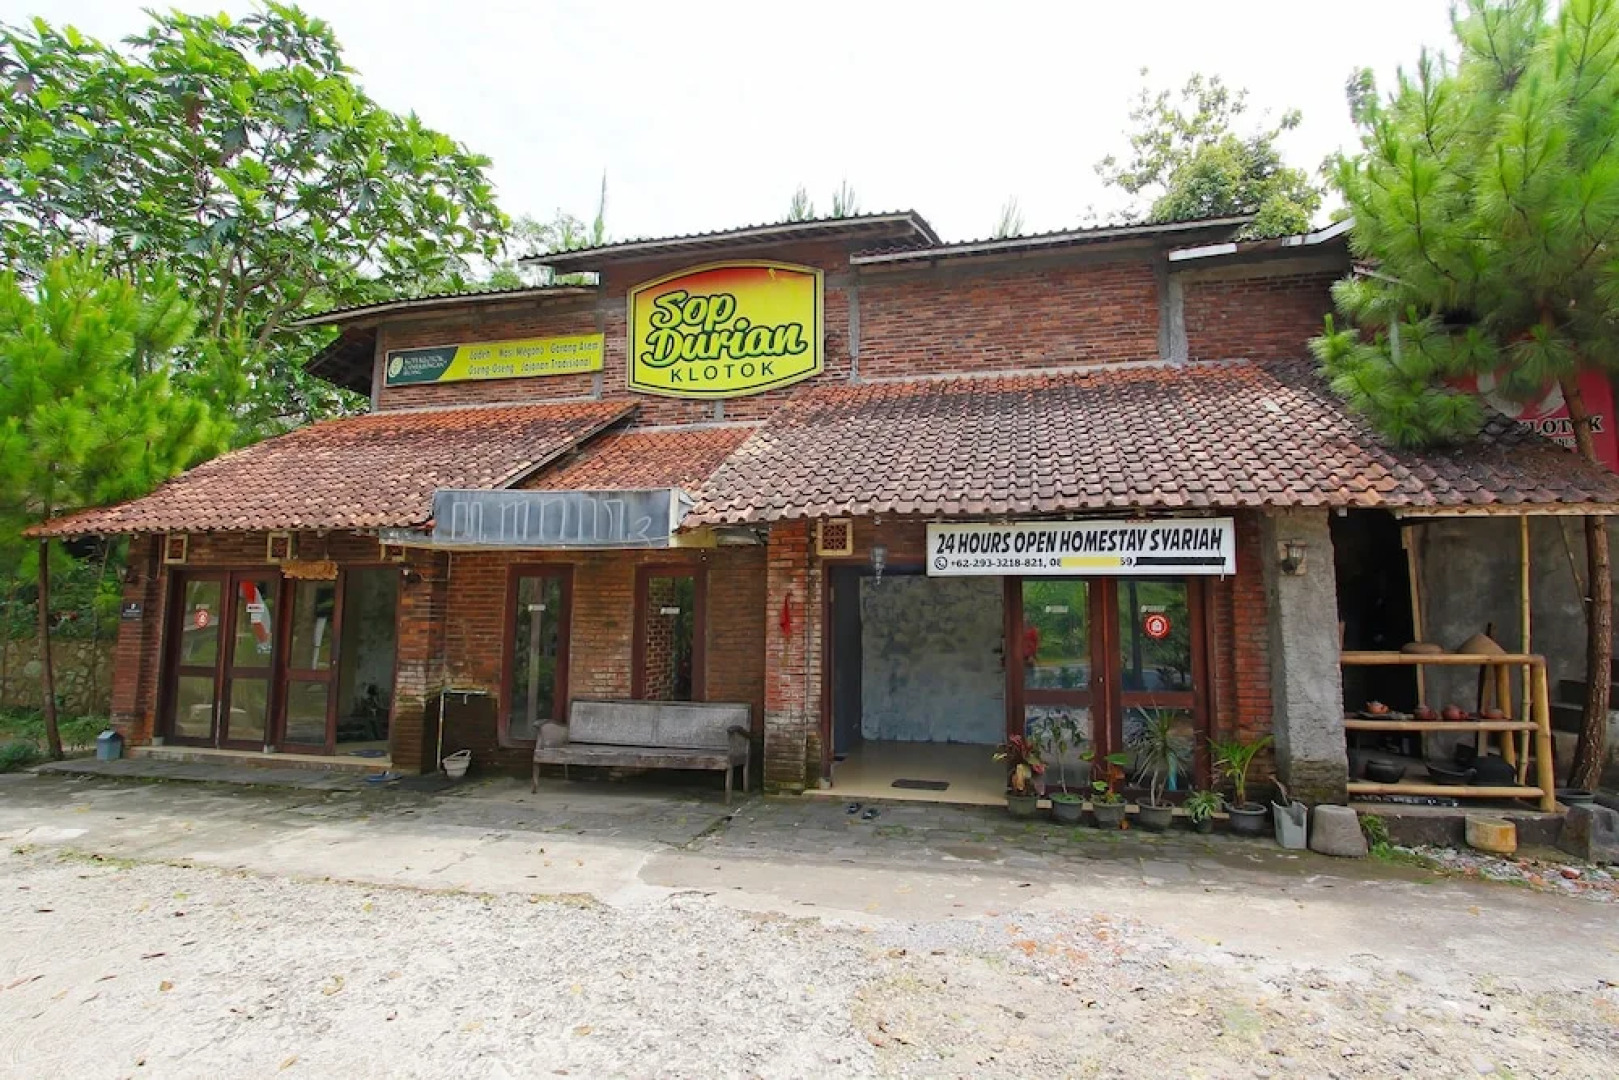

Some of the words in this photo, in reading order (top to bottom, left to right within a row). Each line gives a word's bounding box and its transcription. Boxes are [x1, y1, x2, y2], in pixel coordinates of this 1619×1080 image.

[650, 290, 736, 331] Sop
[640, 317, 809, 367] Durian
[671, 361, 775, 382] KLOTOK
[936, 533, 954, 554] 24
[958, 531, 1011, 553] HOURS
[1014, 530, 1058, 552] OPEN
[1060, 528, 1147, 552] HOMESTAY
[1150, 527, 1222, 551] SYARIAH
